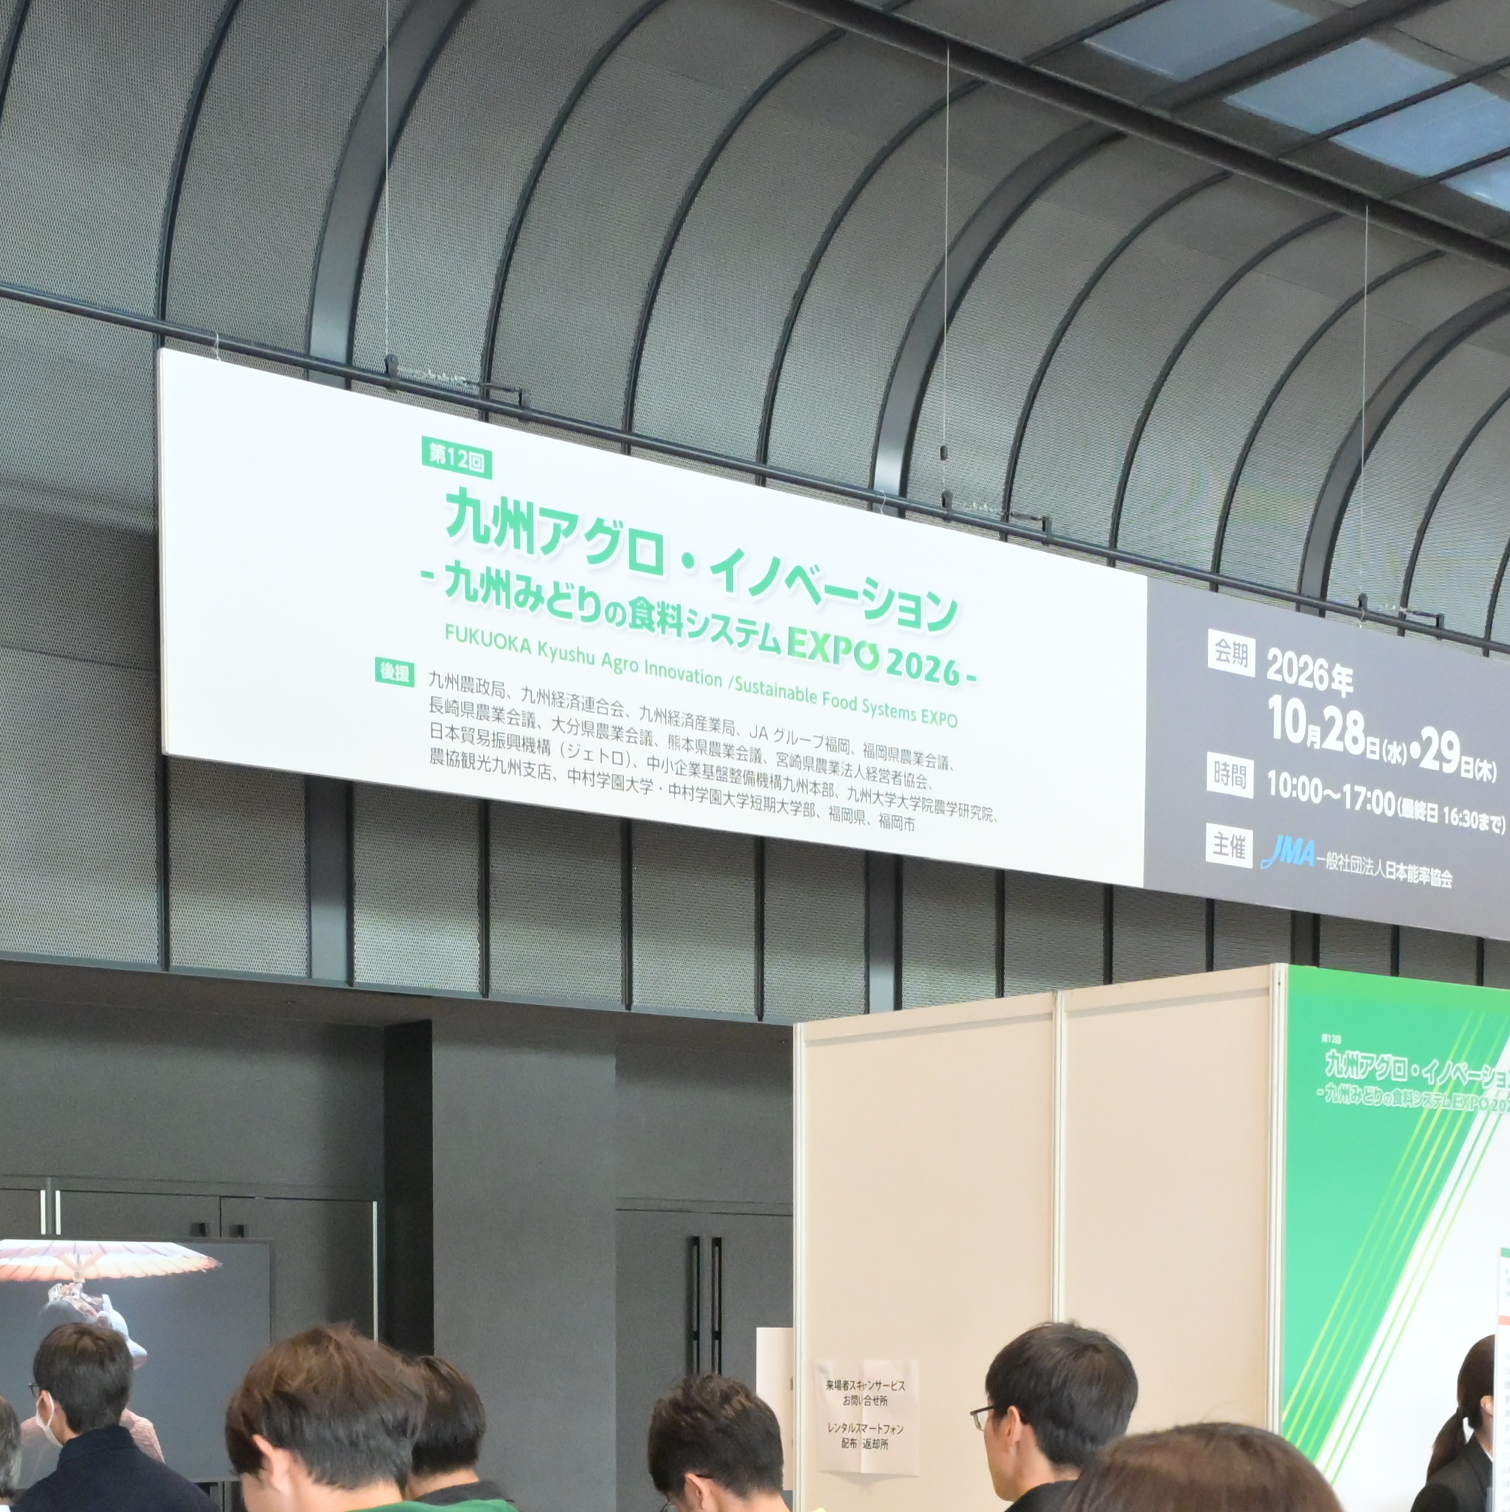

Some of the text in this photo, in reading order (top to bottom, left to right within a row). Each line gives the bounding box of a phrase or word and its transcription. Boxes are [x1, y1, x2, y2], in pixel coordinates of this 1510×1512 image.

[429, 442, 485, 473] 第12回
[445, 486, 959, 631] 九州アグロ・イノベーション
[788, 627, 879, 671] EXPO
[1215, 638, 1248, 668] 会期
[380, 661, 409, 683] 後援
[445, 623, 531, 655] FUKUOKA
[538, 640, 595, 665] Kyushu
[601, 652, 638, 674] Agro
[645, 659, 722, 688] Innovation
[823, 691, 857, 711] Food
[862, 699, 916, 722] Systems
[922, 709, 958, 729] EXPO
[1266, 647, 1354, 699] 2026年
[1214, 761, 1247, 790] 時間
[1213, 831, 1246, 860] 主催
[1260, 835, 1315, 869] JMA
[826, 1379, 906, 1392] 来場者スキャンサービス
